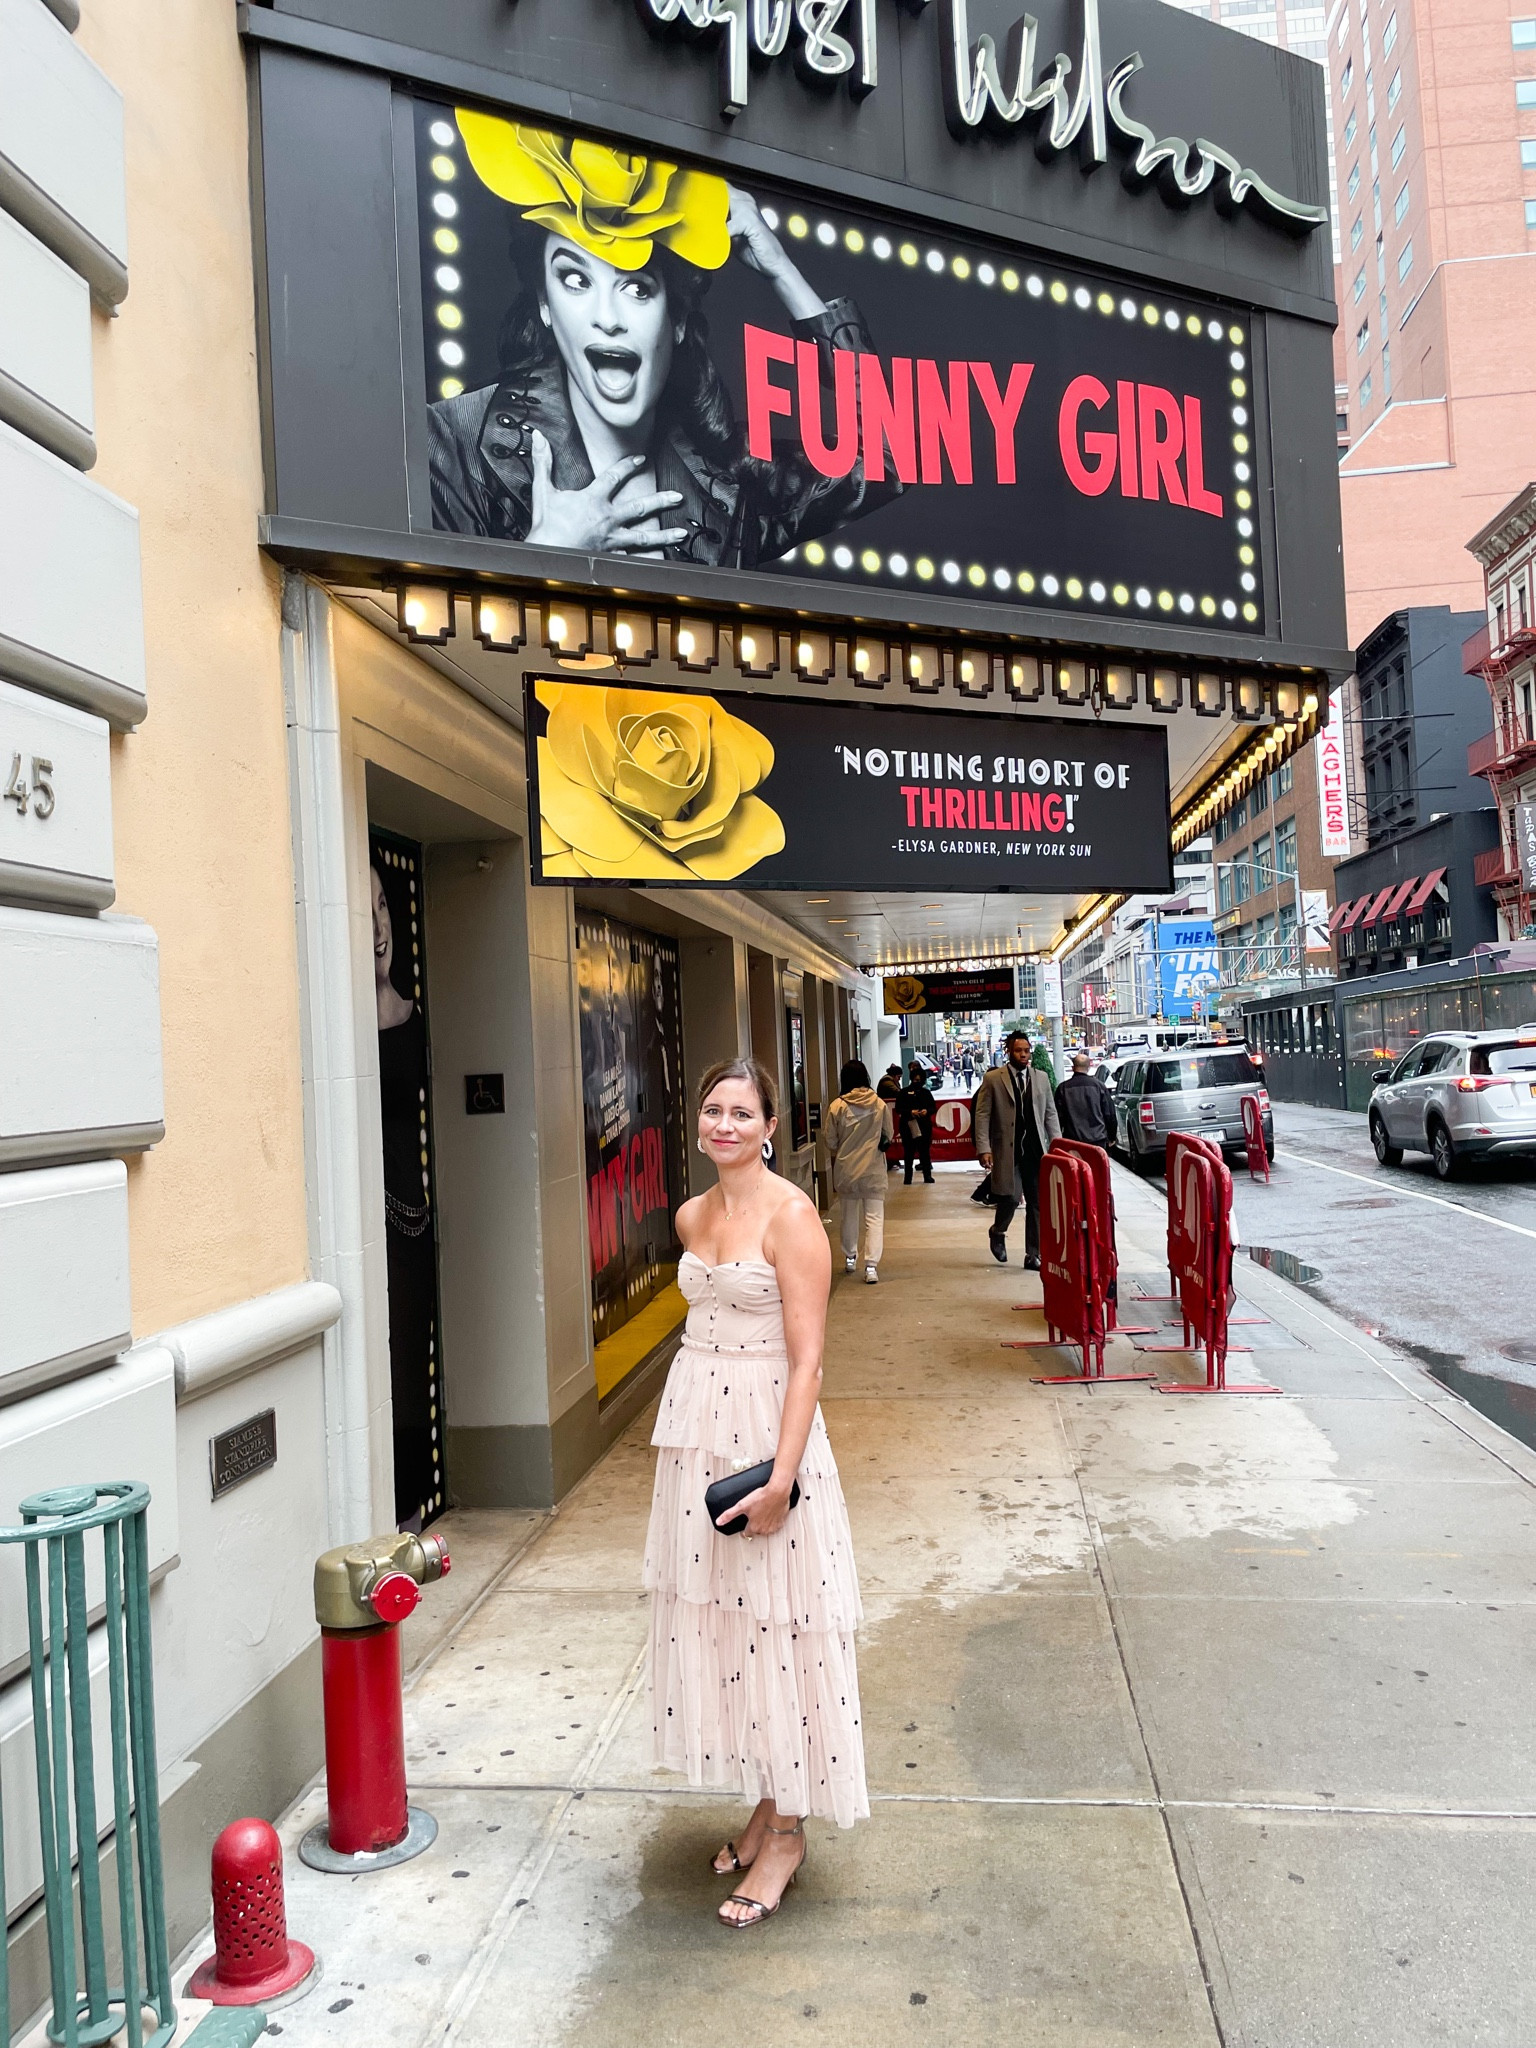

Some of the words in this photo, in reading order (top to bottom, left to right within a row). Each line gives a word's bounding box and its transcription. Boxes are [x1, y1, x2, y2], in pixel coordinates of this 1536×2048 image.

[744, 323, 1035, 485] FUNNY
[1058, 374, 1224, 518] GIRL
[4, 752, 55, 820] 45
[834, 745, 983, 782] “NOTHING
[992, 756, 1086, 787] SHORT
[1094, 762, 1131, 789] OF
[900, 786, 1080, 834] THRILLING!”
[891, 840, 936, 853] -ELYSA
[940, 840, 1000, 857] GARDNER,
[1005, 843, 1031, 856] NEW
[1035, 844, 1066, 857] YORK
[1069, 845, 1092, 857] SUN
[1326, 836, 1347, 846] BAR
[1174, 931, 1204, 945] THE
[630, 1126, 668, 1224] GIRL
[224, 1435, 267, 1468] STANDPIPE
[228, 1425, 262, 1450] SIAMESE
[219, 1445, 273, 1485] CONNECTION
